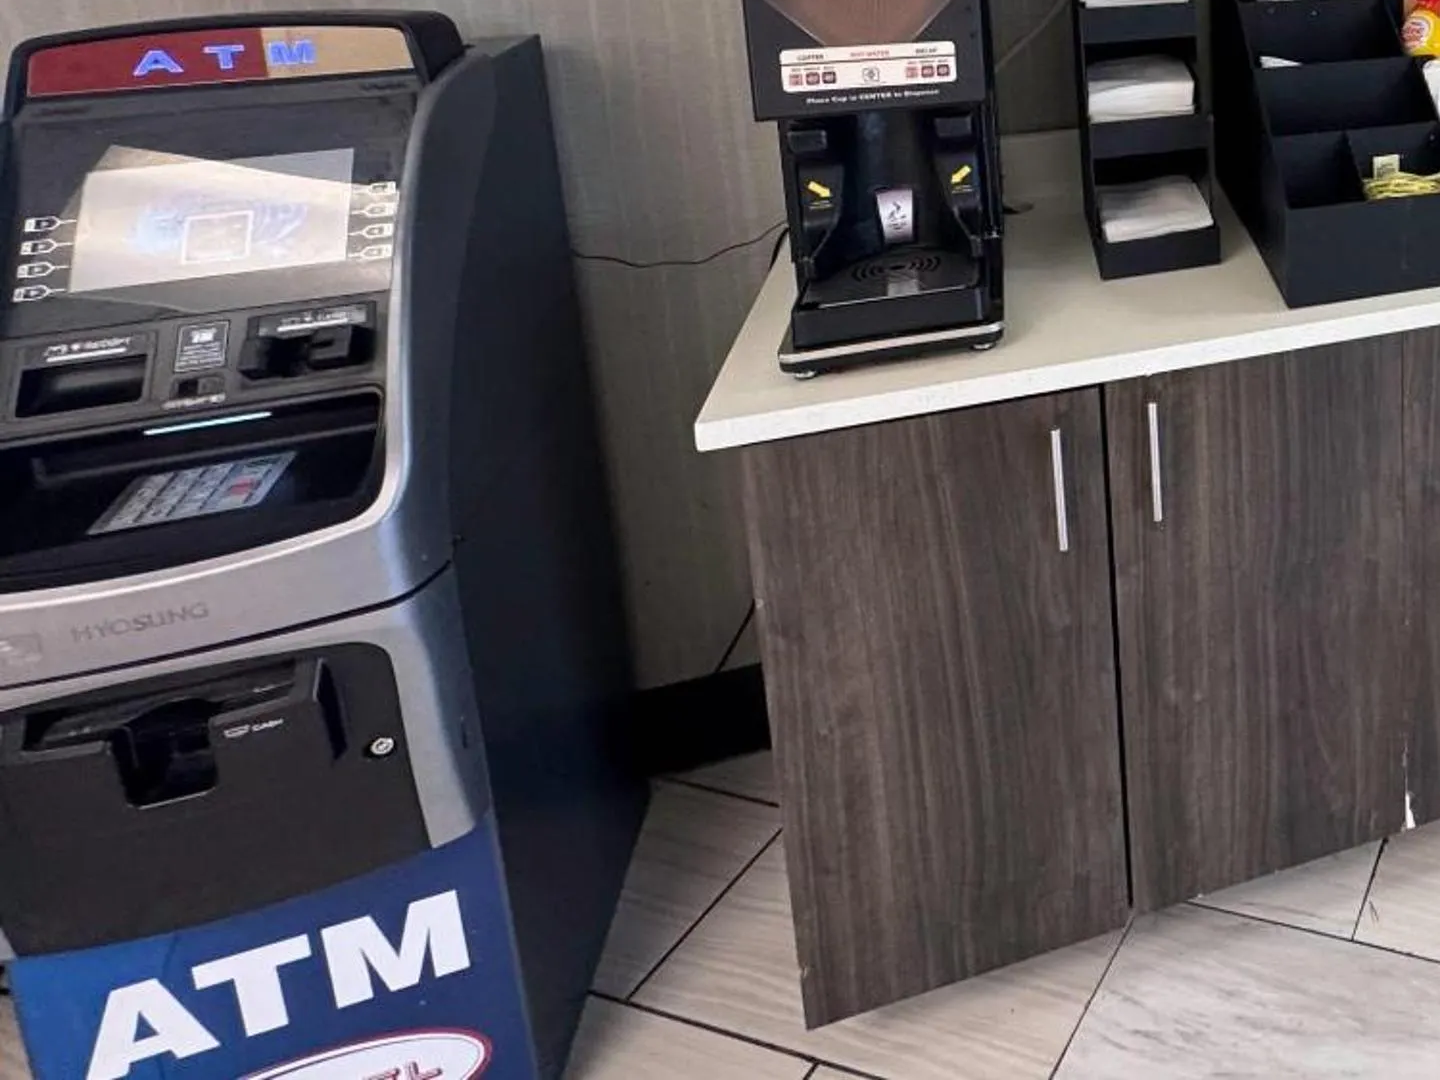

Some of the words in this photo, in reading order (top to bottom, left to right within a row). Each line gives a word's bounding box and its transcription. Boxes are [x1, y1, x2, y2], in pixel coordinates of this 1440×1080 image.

[133, 39, 316, 77] ATM
[70, 602, 210, 641] HYOSUNG
[86, 890, 472, 1080] ATM
